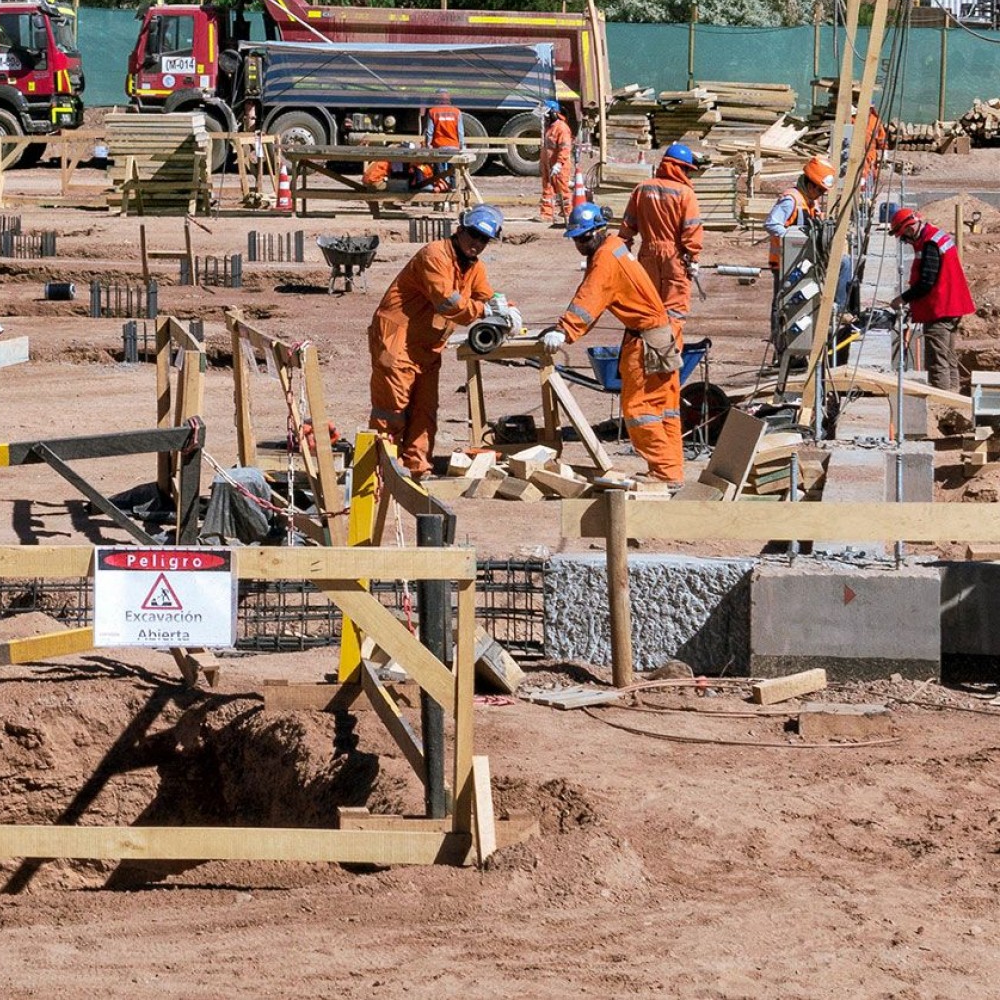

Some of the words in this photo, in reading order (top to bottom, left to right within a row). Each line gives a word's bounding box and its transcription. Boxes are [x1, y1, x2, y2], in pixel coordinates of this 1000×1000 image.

[127, 554, 202, 570] Peligro
[125, 611, 202, 623] Excavación
[137, 629, 190, 641] Abierta
